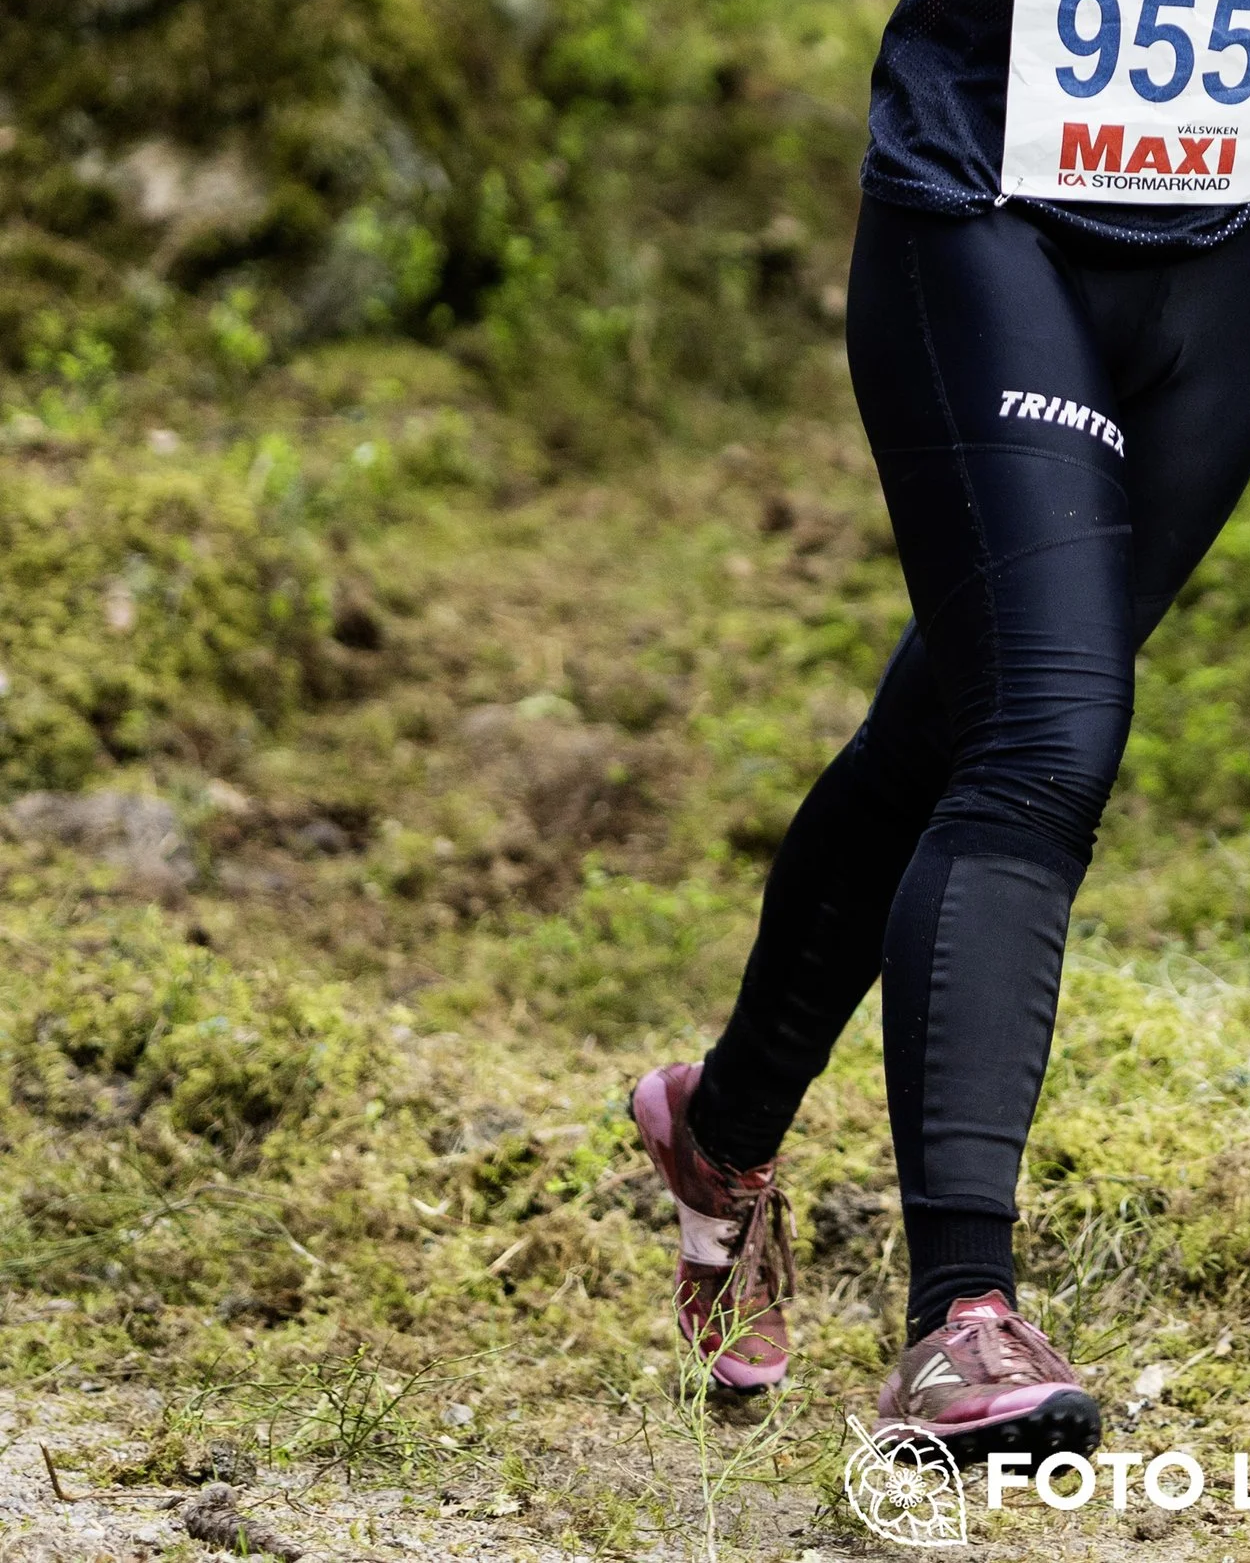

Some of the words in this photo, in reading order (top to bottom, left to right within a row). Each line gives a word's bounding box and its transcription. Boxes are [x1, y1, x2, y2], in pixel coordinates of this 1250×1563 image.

[1177, 124, 1239, 135] VÄLSVIKEN
[1059, 122, 1237, 175] MAXI
[1058, 173, 1087, 187] ICA
[1092, 174, 1230, 191] STORMARKNAD
[999, 390, 1125, 458] TRIMTEX
